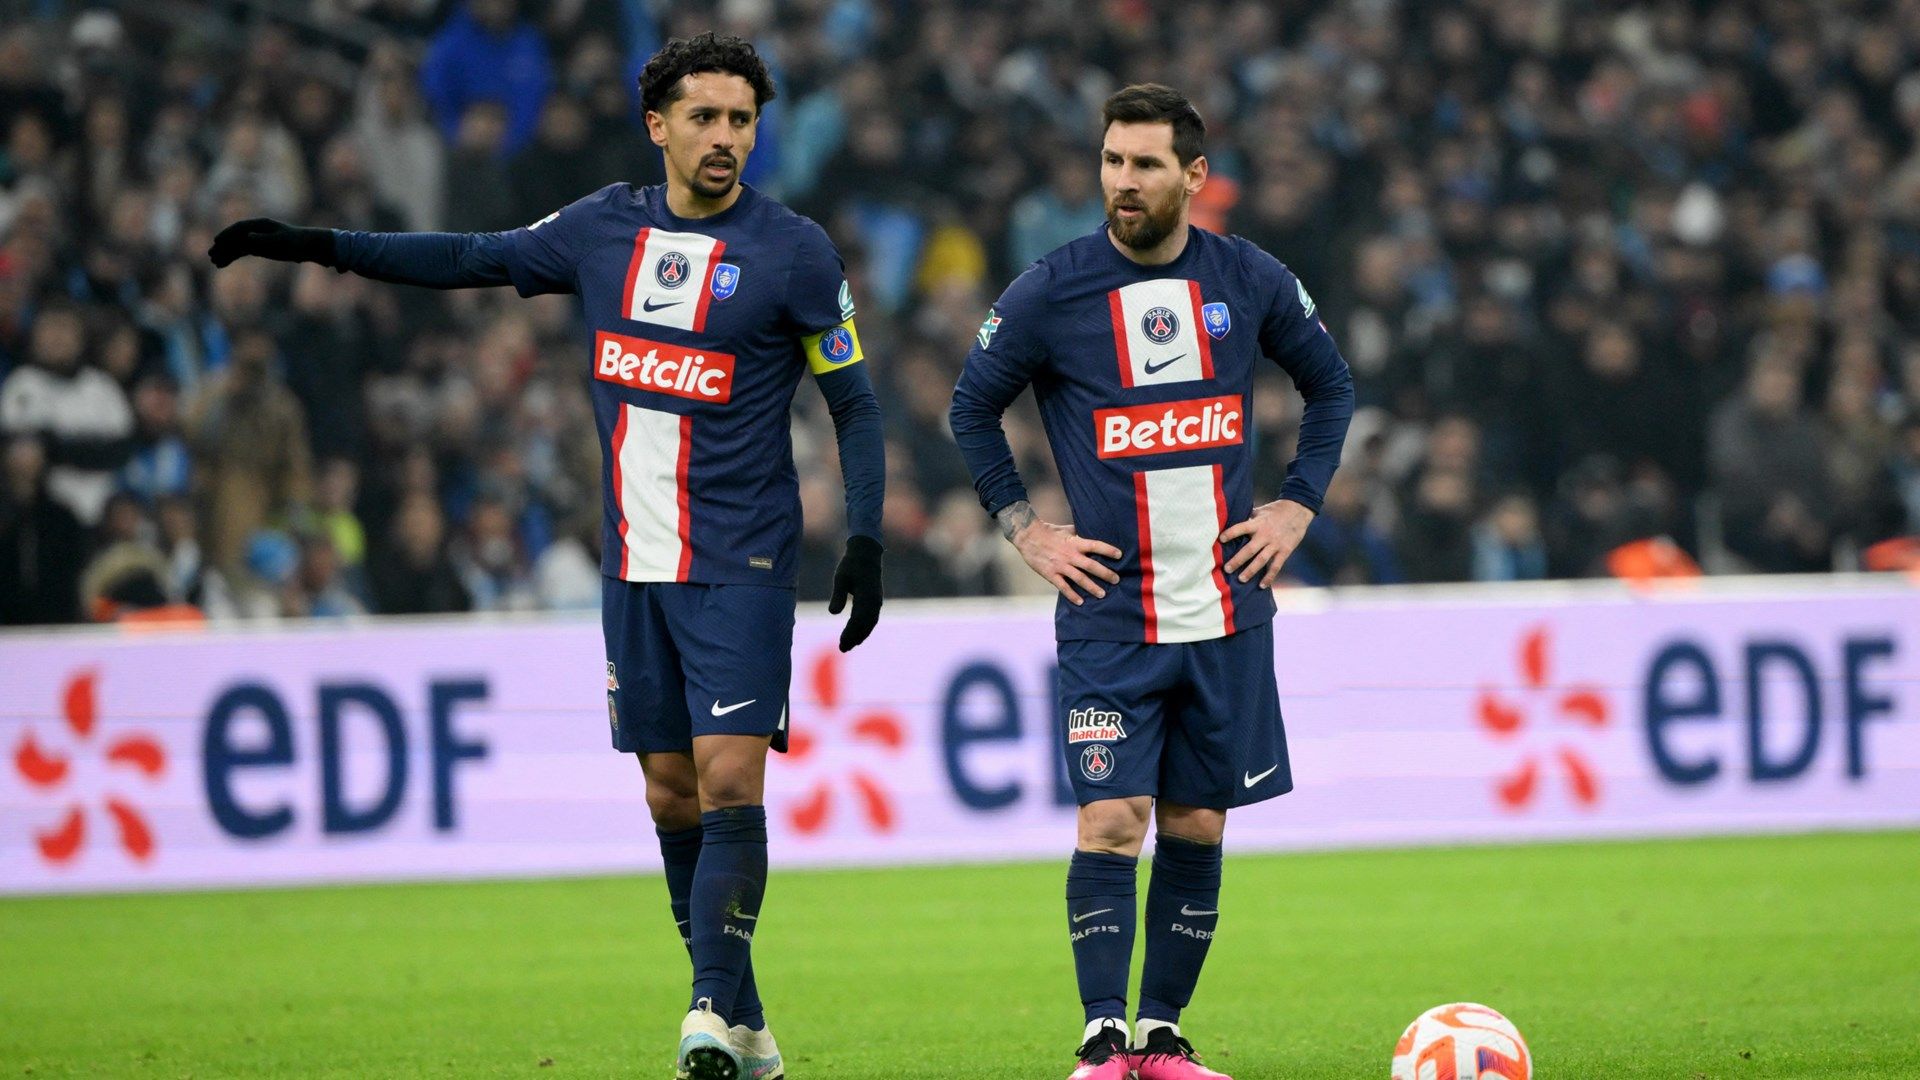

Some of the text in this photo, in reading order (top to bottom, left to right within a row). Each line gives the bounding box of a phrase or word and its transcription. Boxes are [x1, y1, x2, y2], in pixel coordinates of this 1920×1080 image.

[664, 254, 686, 266] PARIS
[1147, 309, 1171, 320] PARIS
[824, 329, 846, 342] PARIS
[598, 340, 726, 396] Betclic
[1104, 402, 1239, 452] Betclic
[1645, 636, 1896, 787] eDF
[203, 678, 491, 840] eDF
[1084, 745, 1107, 756] PARIS
[1070, 925, 1120, 942] PARIS
